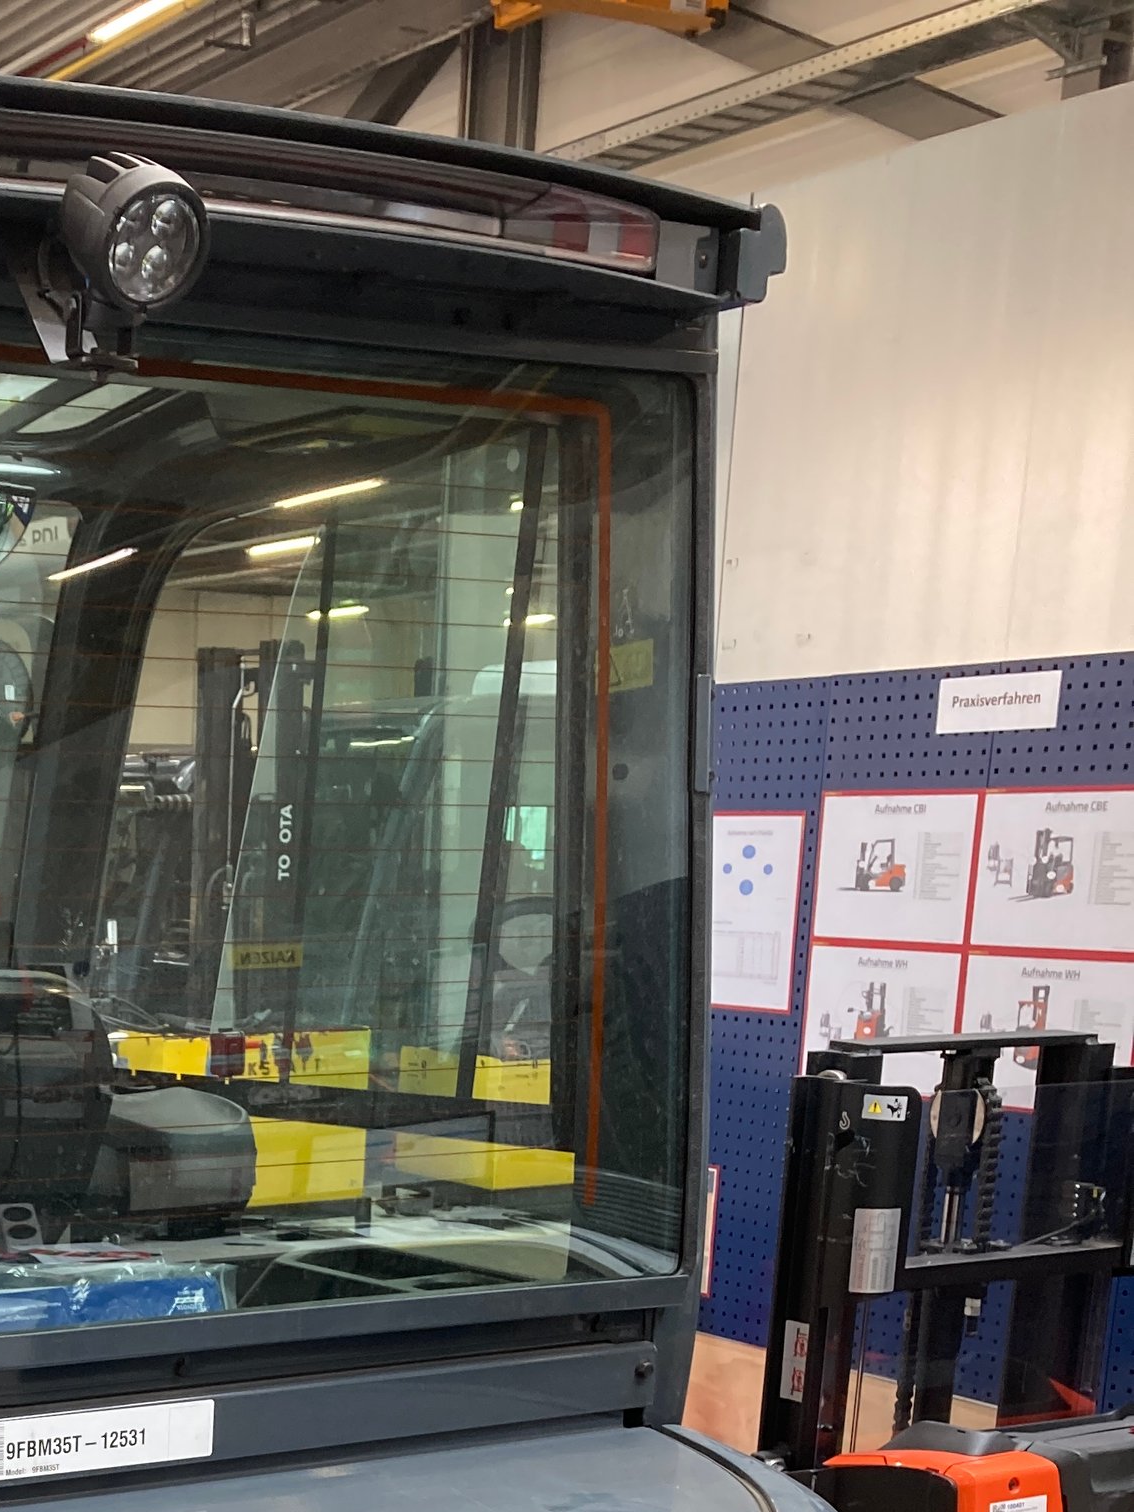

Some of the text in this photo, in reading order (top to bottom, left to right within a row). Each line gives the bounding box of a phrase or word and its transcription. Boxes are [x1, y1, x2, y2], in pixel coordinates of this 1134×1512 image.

[952, 692, 1041, 708] Praxisverfahren
[874, 804, 912, 815] Aufnahme
[1045, 801, 1089, 812] Aufnahme
[857, 956, 893, 968] Aufnahme
[1021, 966, 1063, 979] Aufnahme
